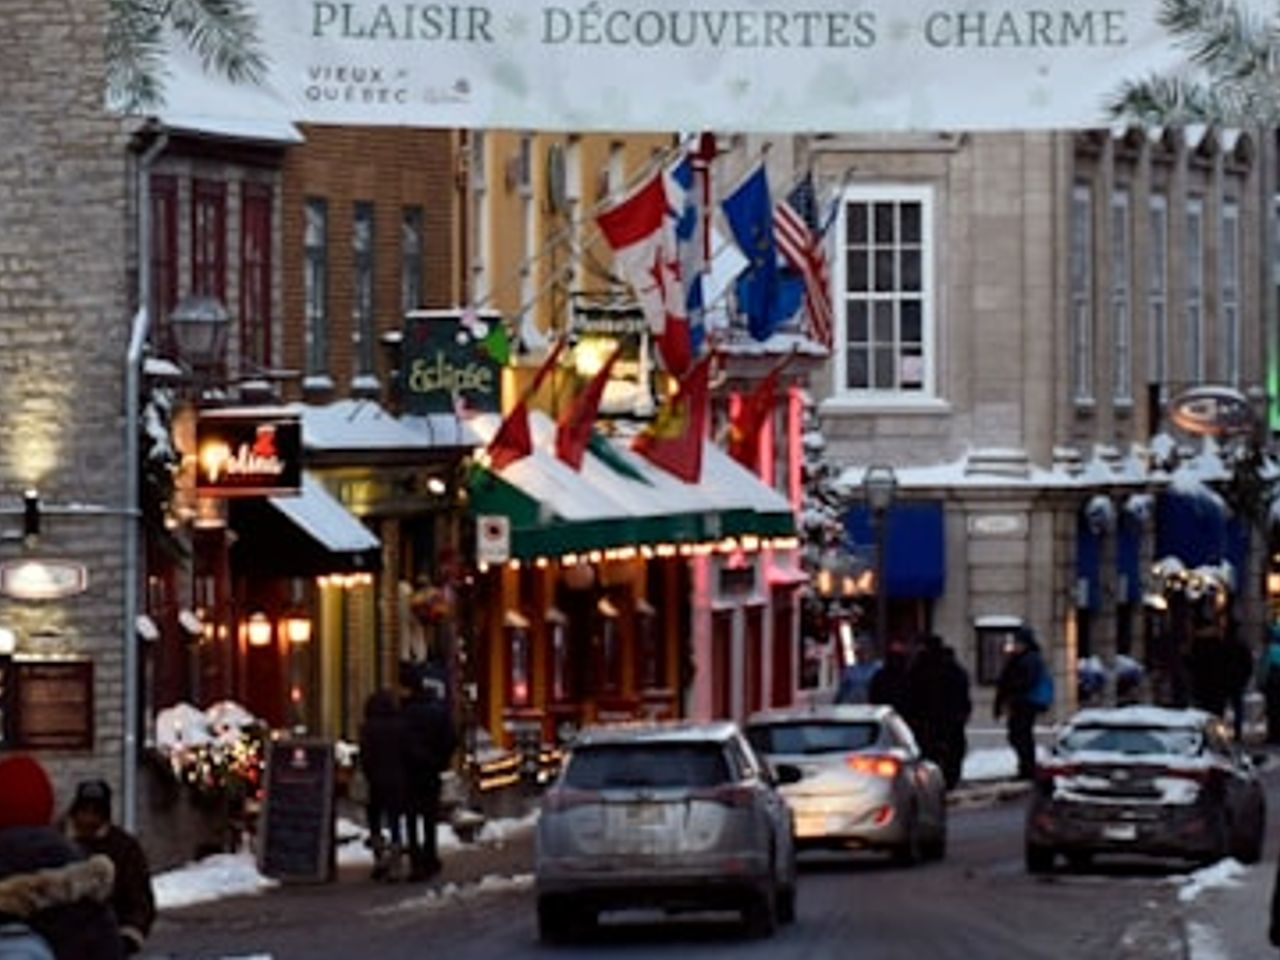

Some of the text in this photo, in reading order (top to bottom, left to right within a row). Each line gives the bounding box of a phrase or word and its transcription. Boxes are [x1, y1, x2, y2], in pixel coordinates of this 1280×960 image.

[311, 0, 1129, 49] PLAISIR DÉCOUVERTES CHARME
[308, 66, 383, 83] VIEUX
[305, 83, 408, 104] QUÉBEC
